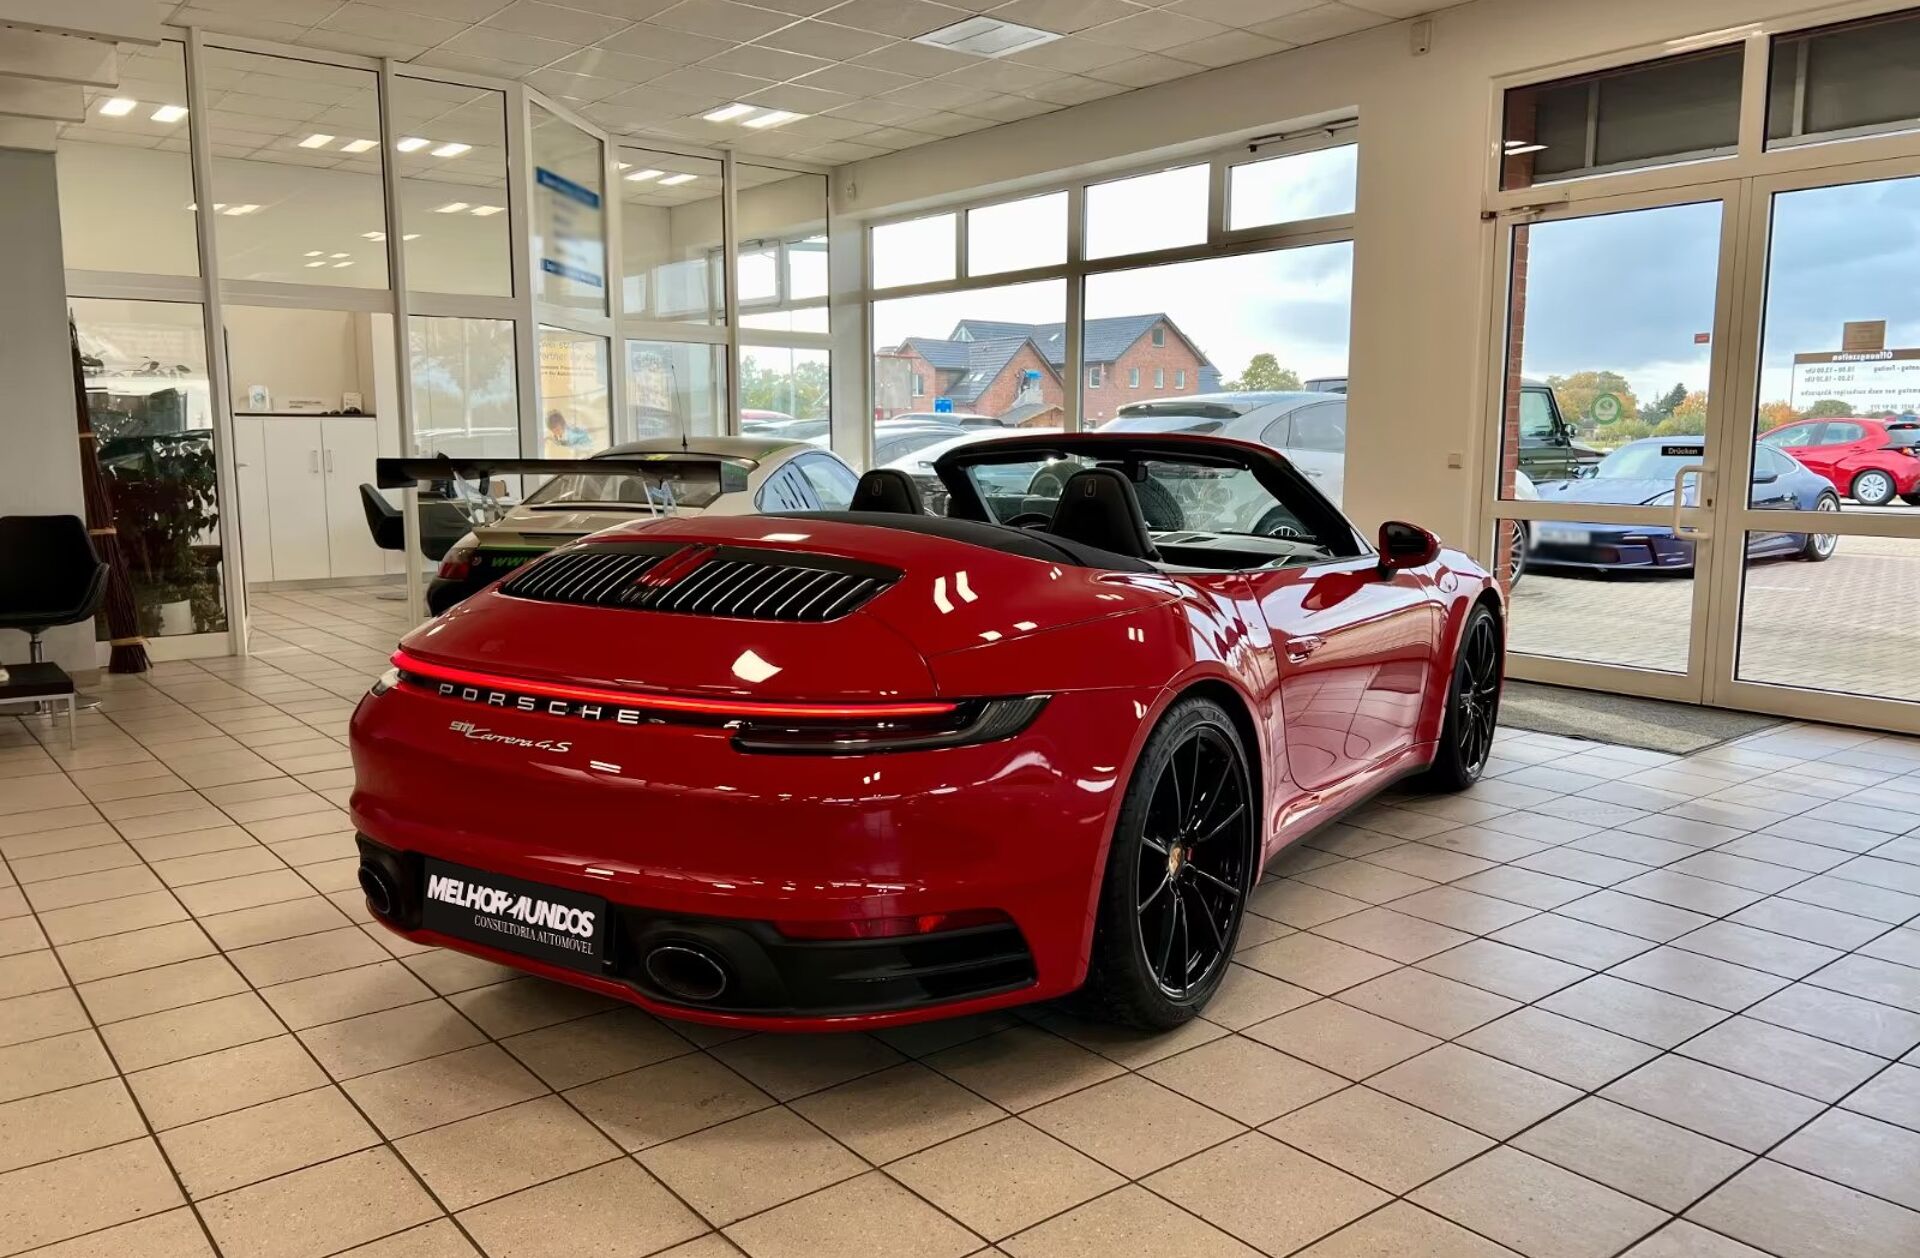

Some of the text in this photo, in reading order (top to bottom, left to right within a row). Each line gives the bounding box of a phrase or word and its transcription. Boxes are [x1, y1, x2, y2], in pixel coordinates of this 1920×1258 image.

[1668, 446, 1698, 455] Drücken
[438, 683, 640, 725] PORSCHE
[465, 728, 534, 748] Carrera
[474, 915, 594, 955] CONSULTORIA AUTOMÓVEL
